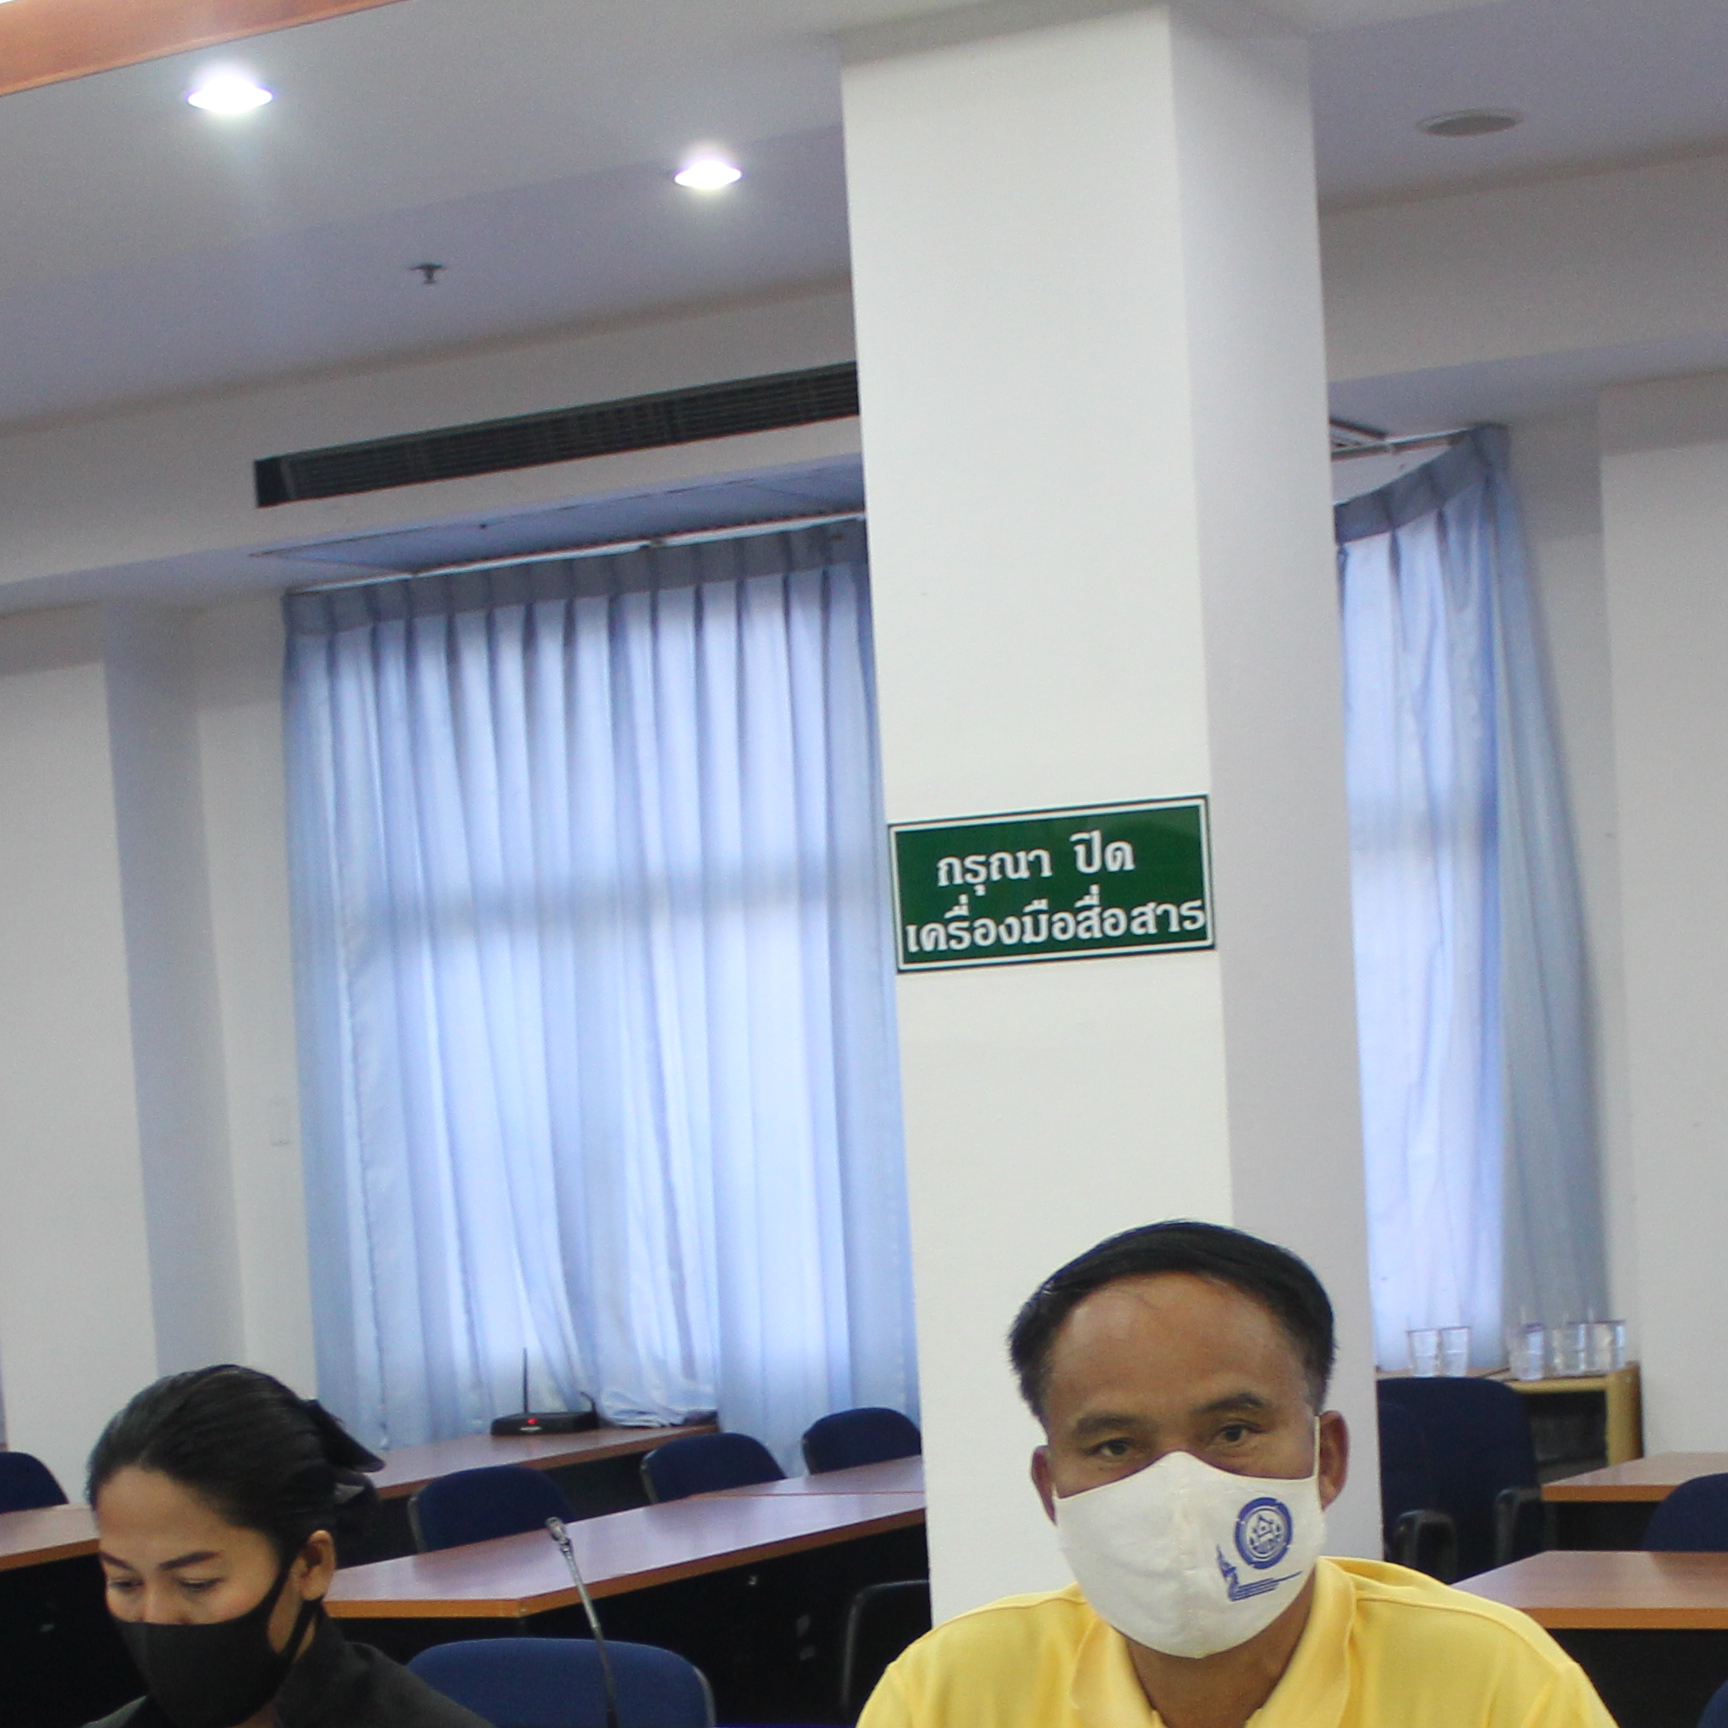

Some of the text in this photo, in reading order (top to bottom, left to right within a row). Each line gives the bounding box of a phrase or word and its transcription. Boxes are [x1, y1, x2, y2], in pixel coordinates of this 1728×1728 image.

[936, 829, 1136, 896] กรุณา ปิด
[906, 883, 1206, 952] เครื่องมือสื่อสาร
